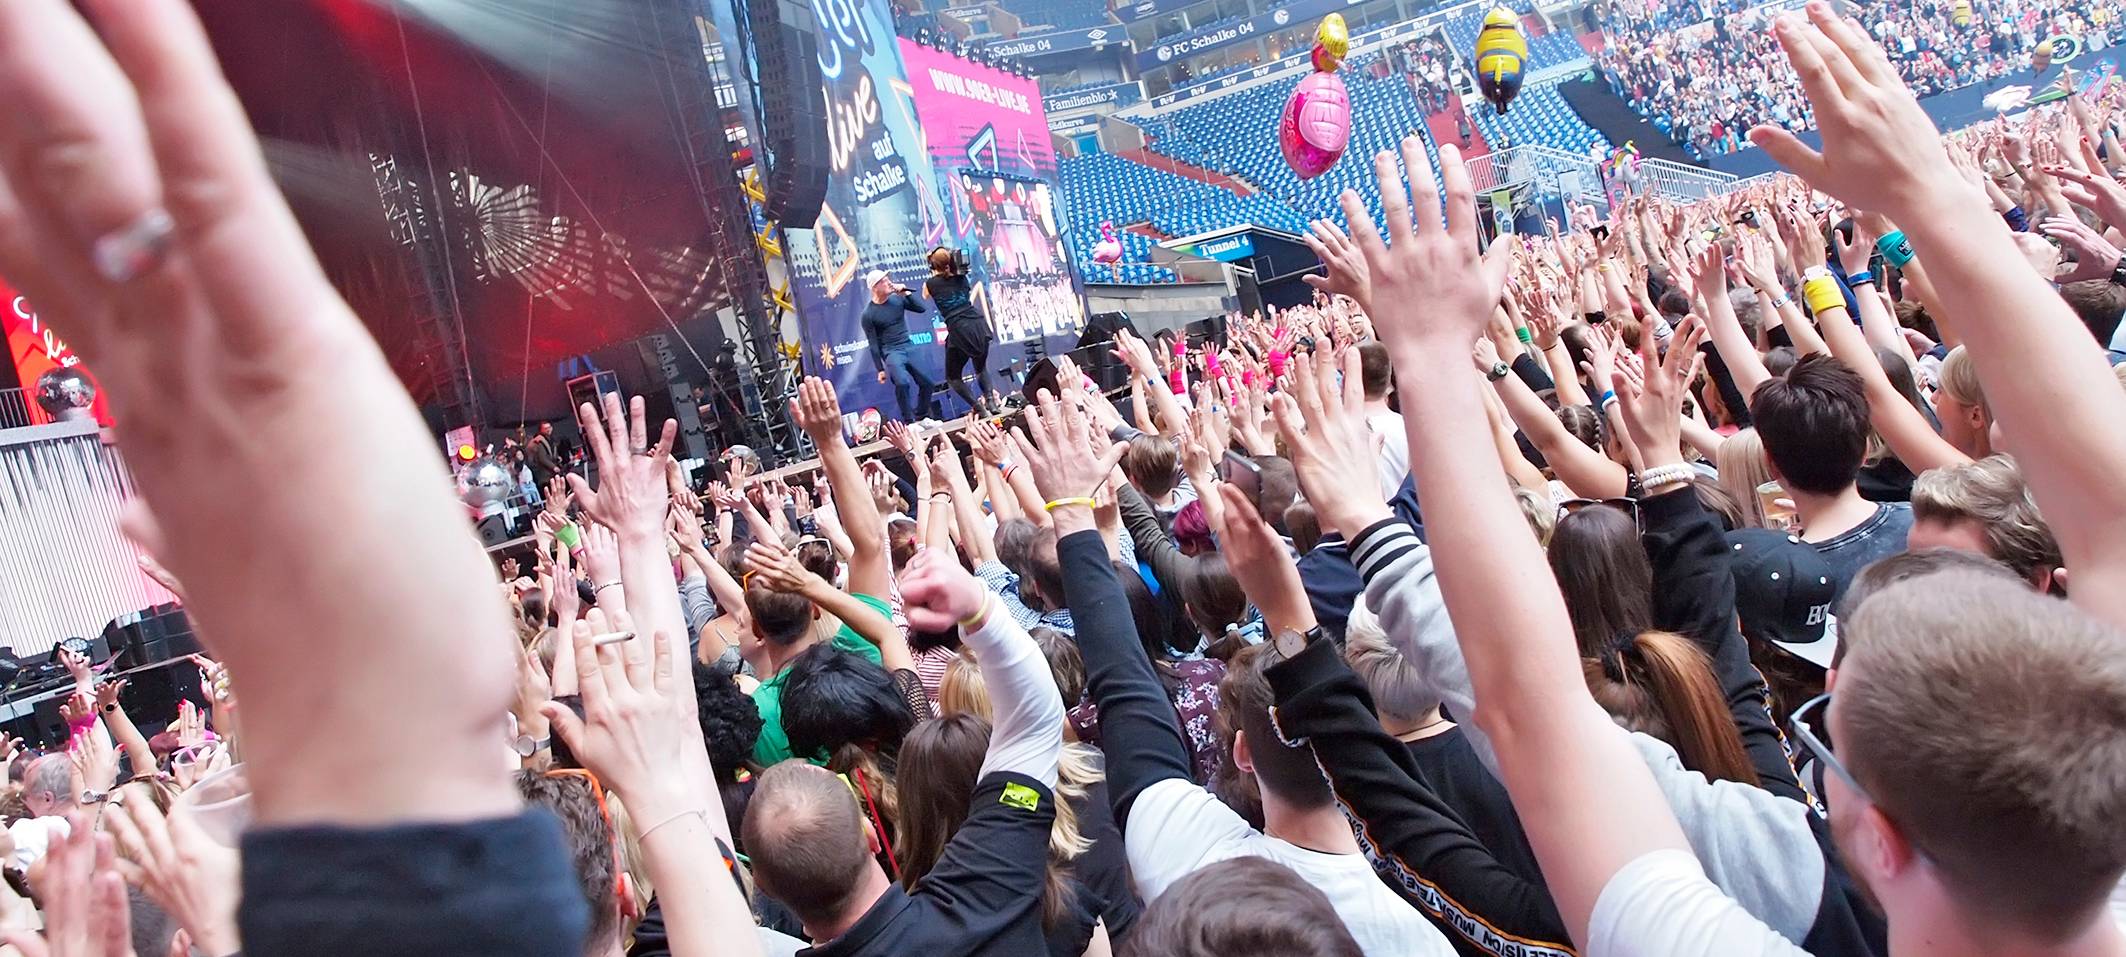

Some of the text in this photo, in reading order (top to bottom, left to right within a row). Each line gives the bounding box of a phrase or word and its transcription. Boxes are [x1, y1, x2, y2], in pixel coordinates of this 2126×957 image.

[994, 41, 1036, 57] Schalke
[1037, 39, 1051, 51] 04
[1172, 21, 1254, 56] FC Schalke 04
[872, 130, 895, 160] auf
[853, 163, 906, 202] Schalke
[1199, 234, 1249, 256] Tunnel 4
